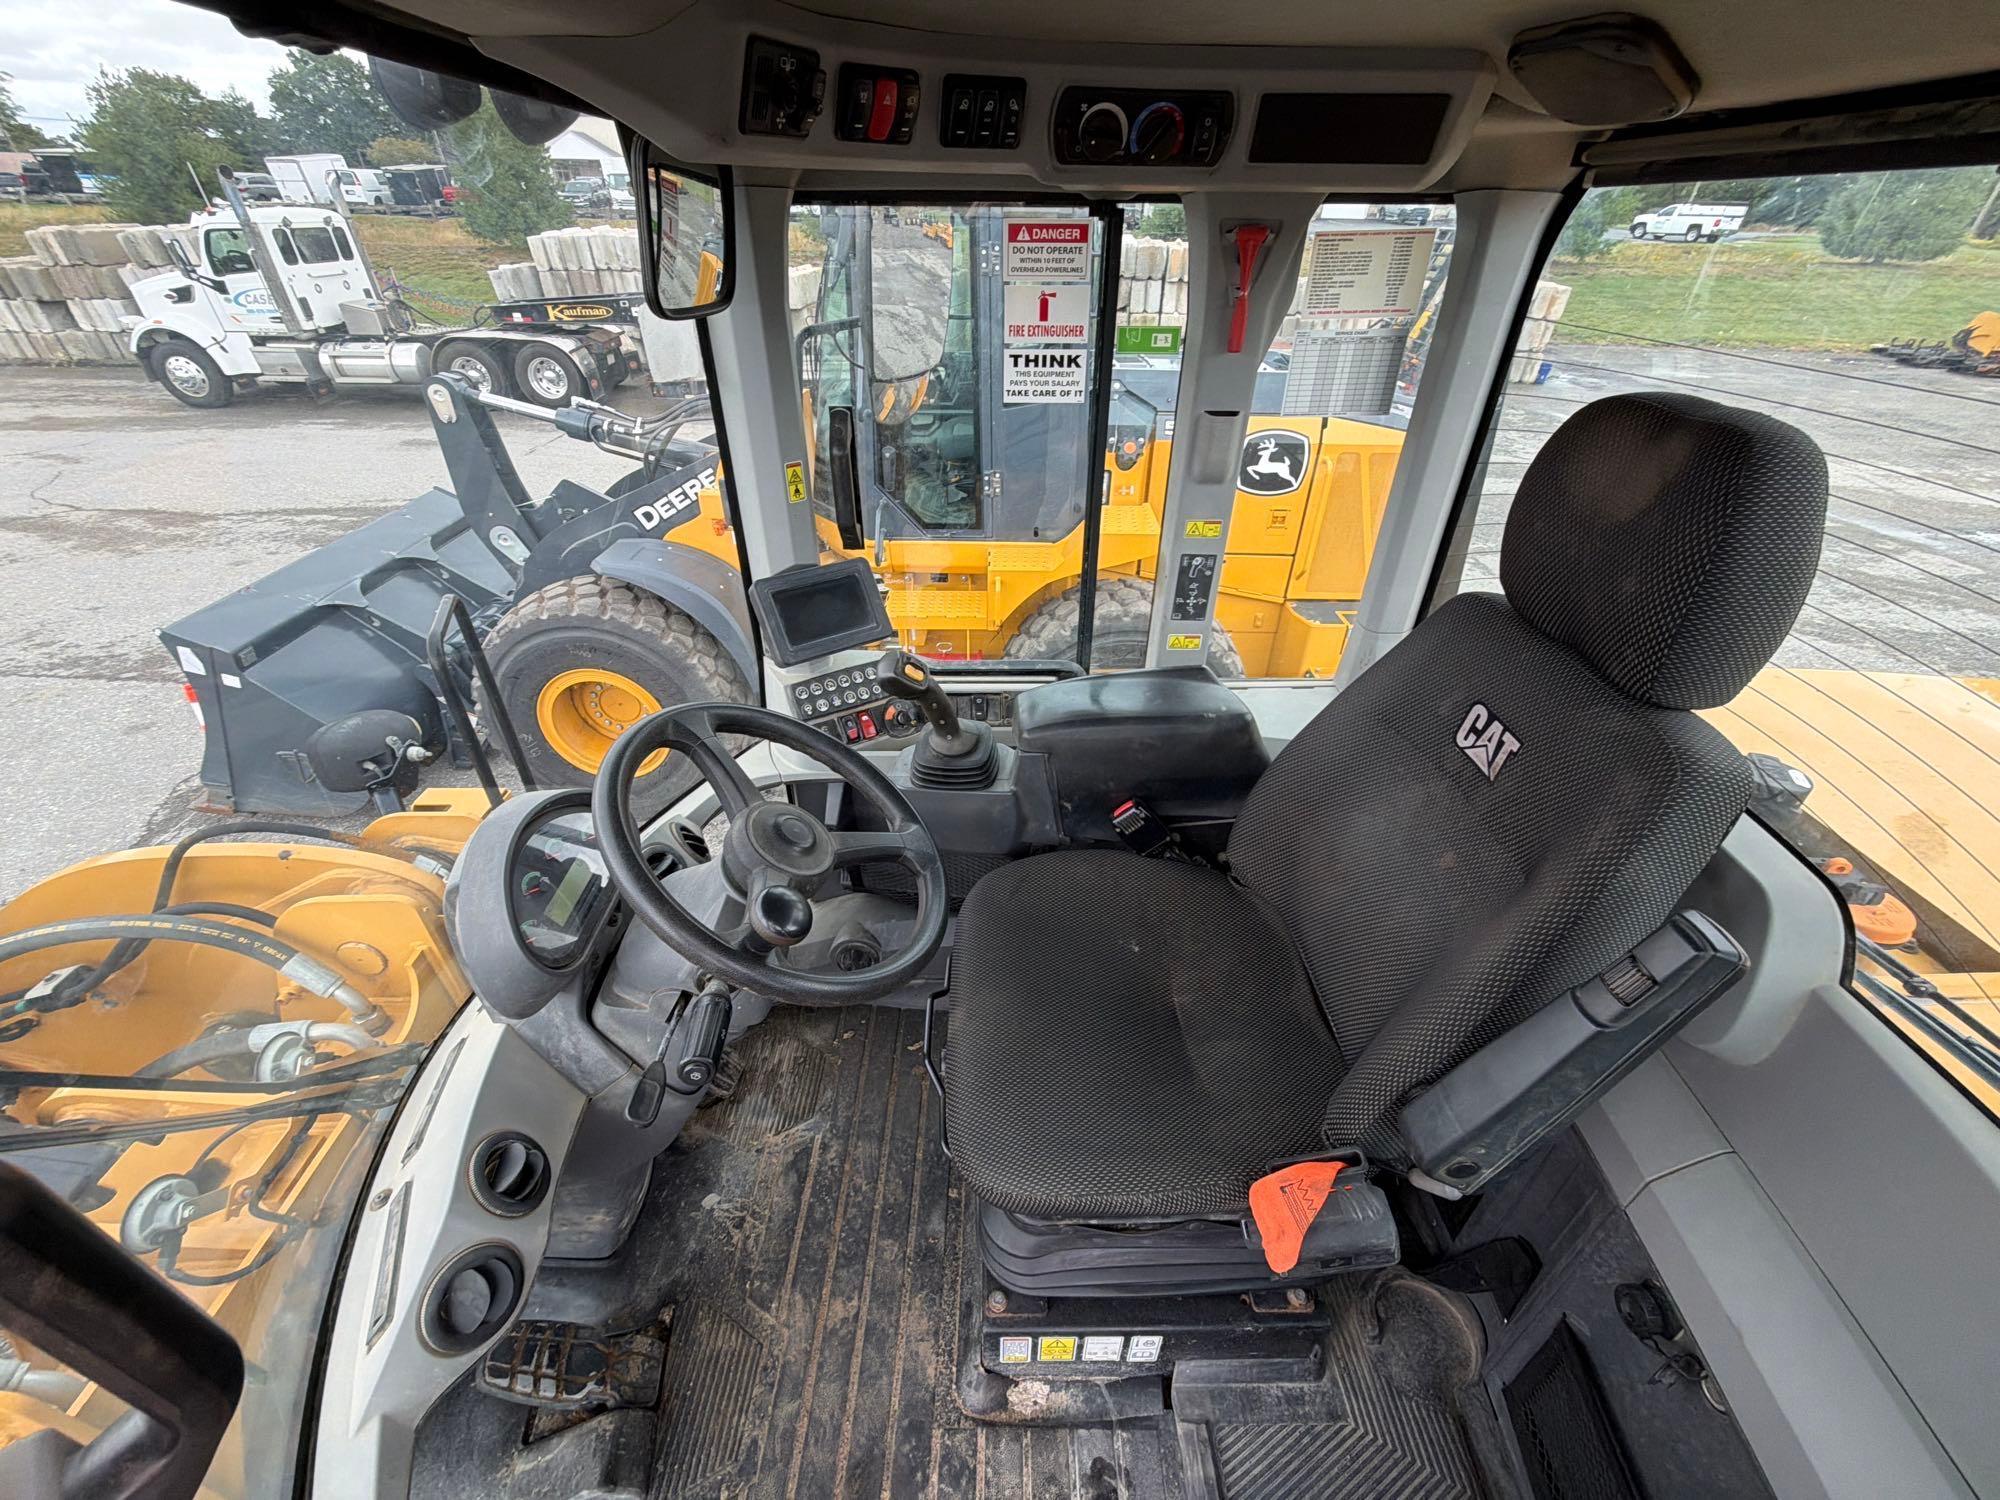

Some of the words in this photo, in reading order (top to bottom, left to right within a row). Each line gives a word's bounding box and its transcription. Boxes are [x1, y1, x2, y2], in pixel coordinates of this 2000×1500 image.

[1032, 228, 1081, 240] DANGER
[1012, 246, 1026, 255] DO
[1027, 246, 1044, 255] NOT
[1046, 246, 1083, 255] OPERATE
[1044, 266, 1084, 274] POWERLINES
[544, 304, 607, 321] Kaufman
[1008, 324, 1026, 338] FIRE
[1027, 324, 1085, 338] EXTINGUISHER
[1008, 354, 1082, 369] THINK
[1015, 370, 1032, 378] THIS
[1033, 370, 1075, 378] EQUIPMENT
[1009, 379, 1028, 387] PAYS
[1029, 379, 1050, 387] YOUR
[1051, 379, 1081, 387] SALARY
[1005, 389, 1030, 397] TAKE
[1032, 389, 1057, 397] CARE
[1060, 389, 1072, 397] OF
[1074, 389, 1084, 397] IT
[632, 467, 717, 531] DEERE
[1455, 703, 1522, 782] CAT
